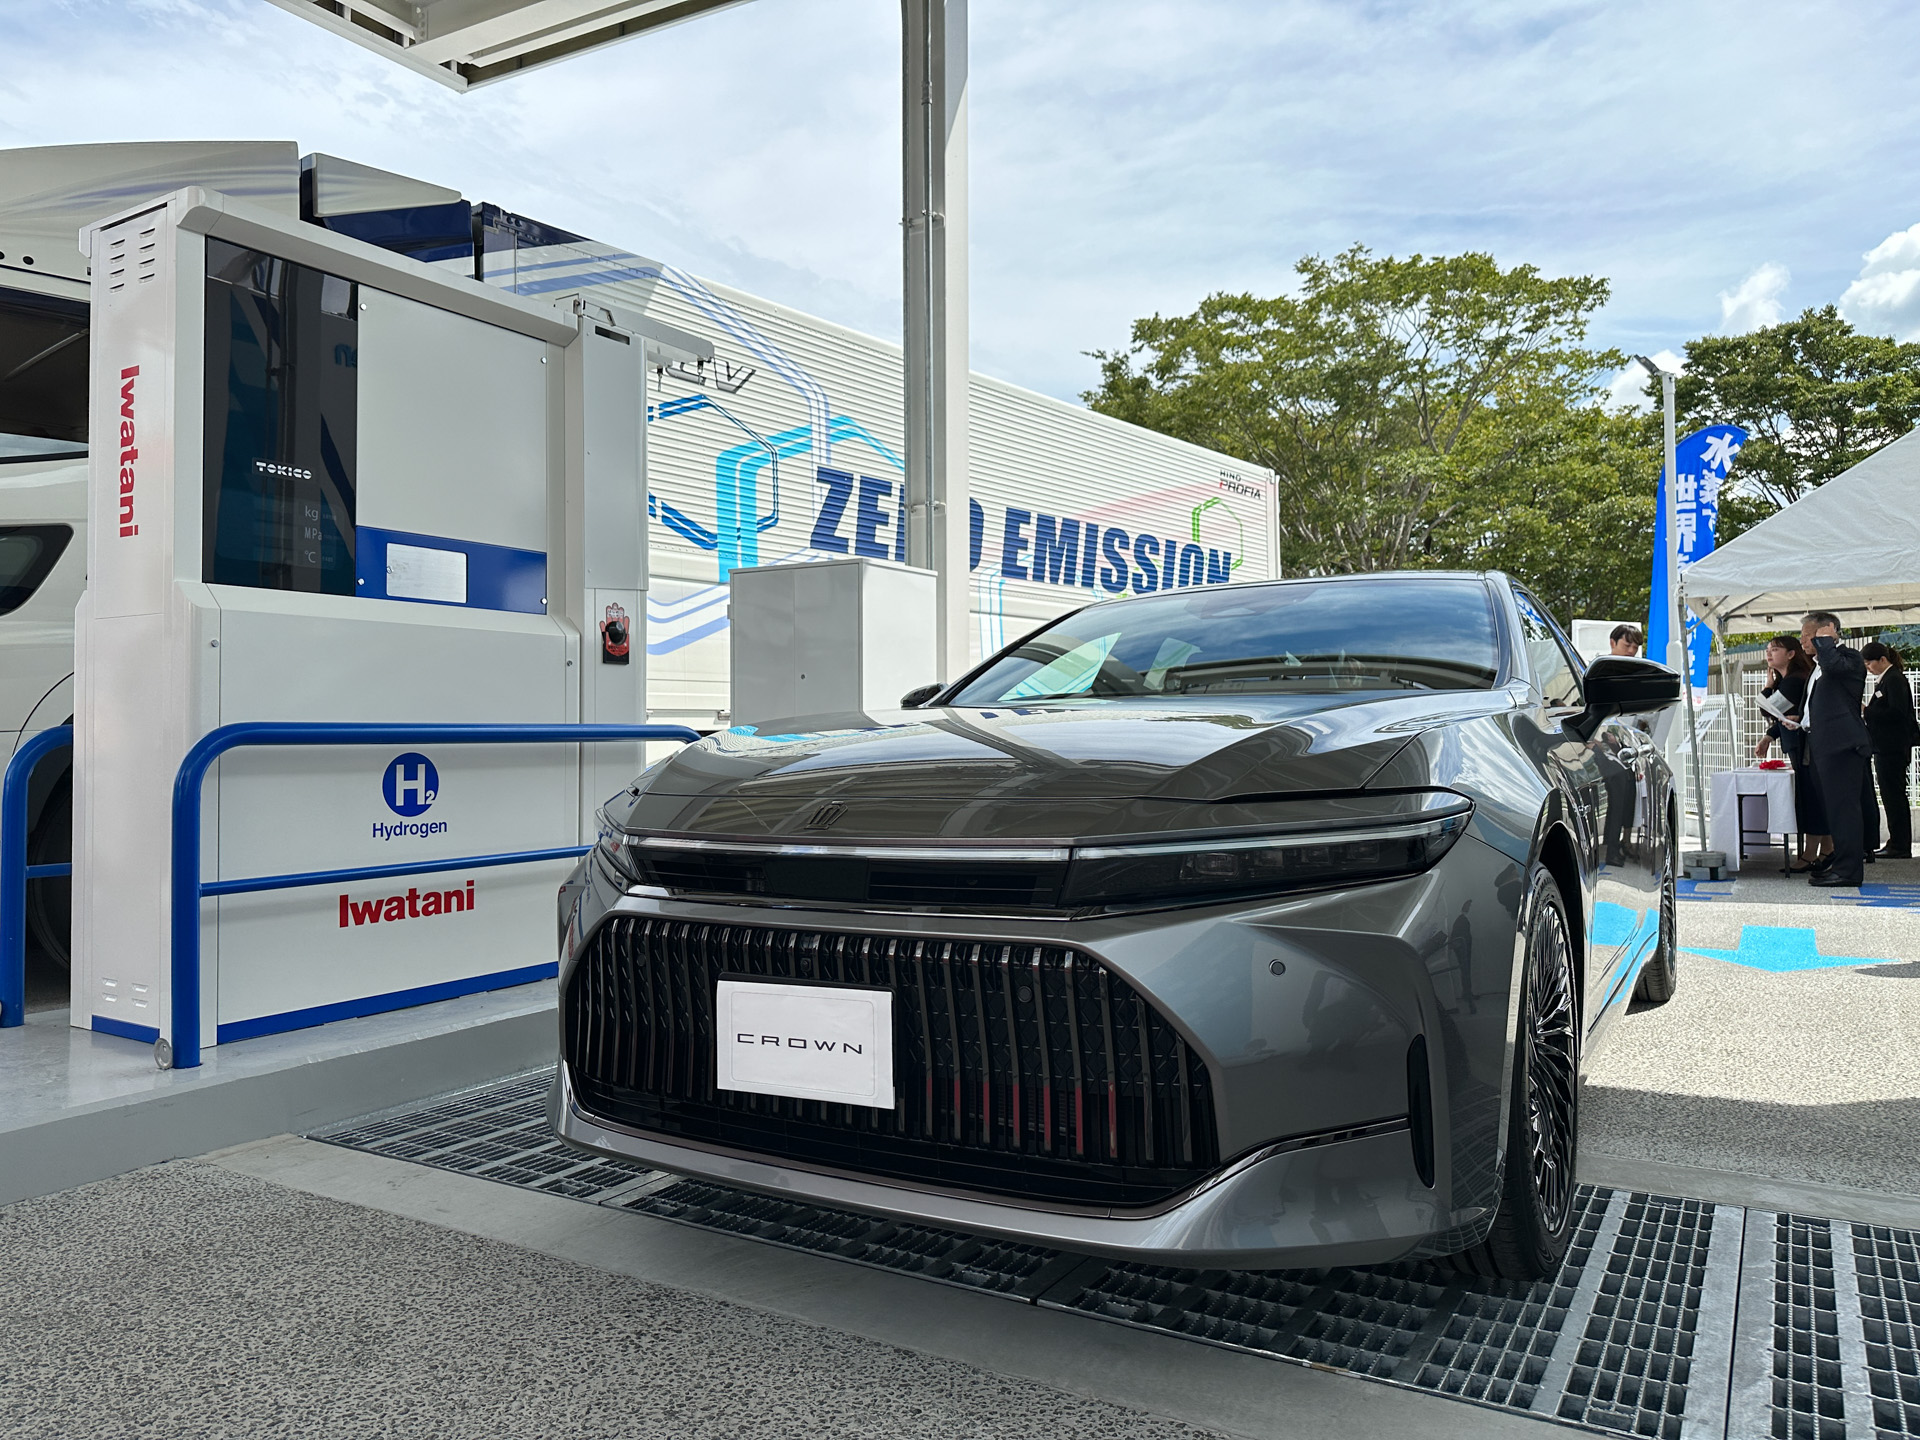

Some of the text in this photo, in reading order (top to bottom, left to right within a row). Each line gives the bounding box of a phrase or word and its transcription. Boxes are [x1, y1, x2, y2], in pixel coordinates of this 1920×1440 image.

[119, 364, 140, 538] Iwatani
[255, 461, 313, 480] TOKICO
[1219, 469, 1242, 482] HINO
[1219, 478, 1261, 500] PROFIA
[304, 505, 319, 521] kg
[304, 527, 323, 541] MPa
[809, 465, 1233, 595] ZE EMISSION
[304, 549, 317, 564] °C
[395, 763, 436, 807] H2
[372, 821, 448, 842] Hydrogen
[339, 879, 475, 929] Iwatani
[736, 1033, 863, 1055] CROWN
